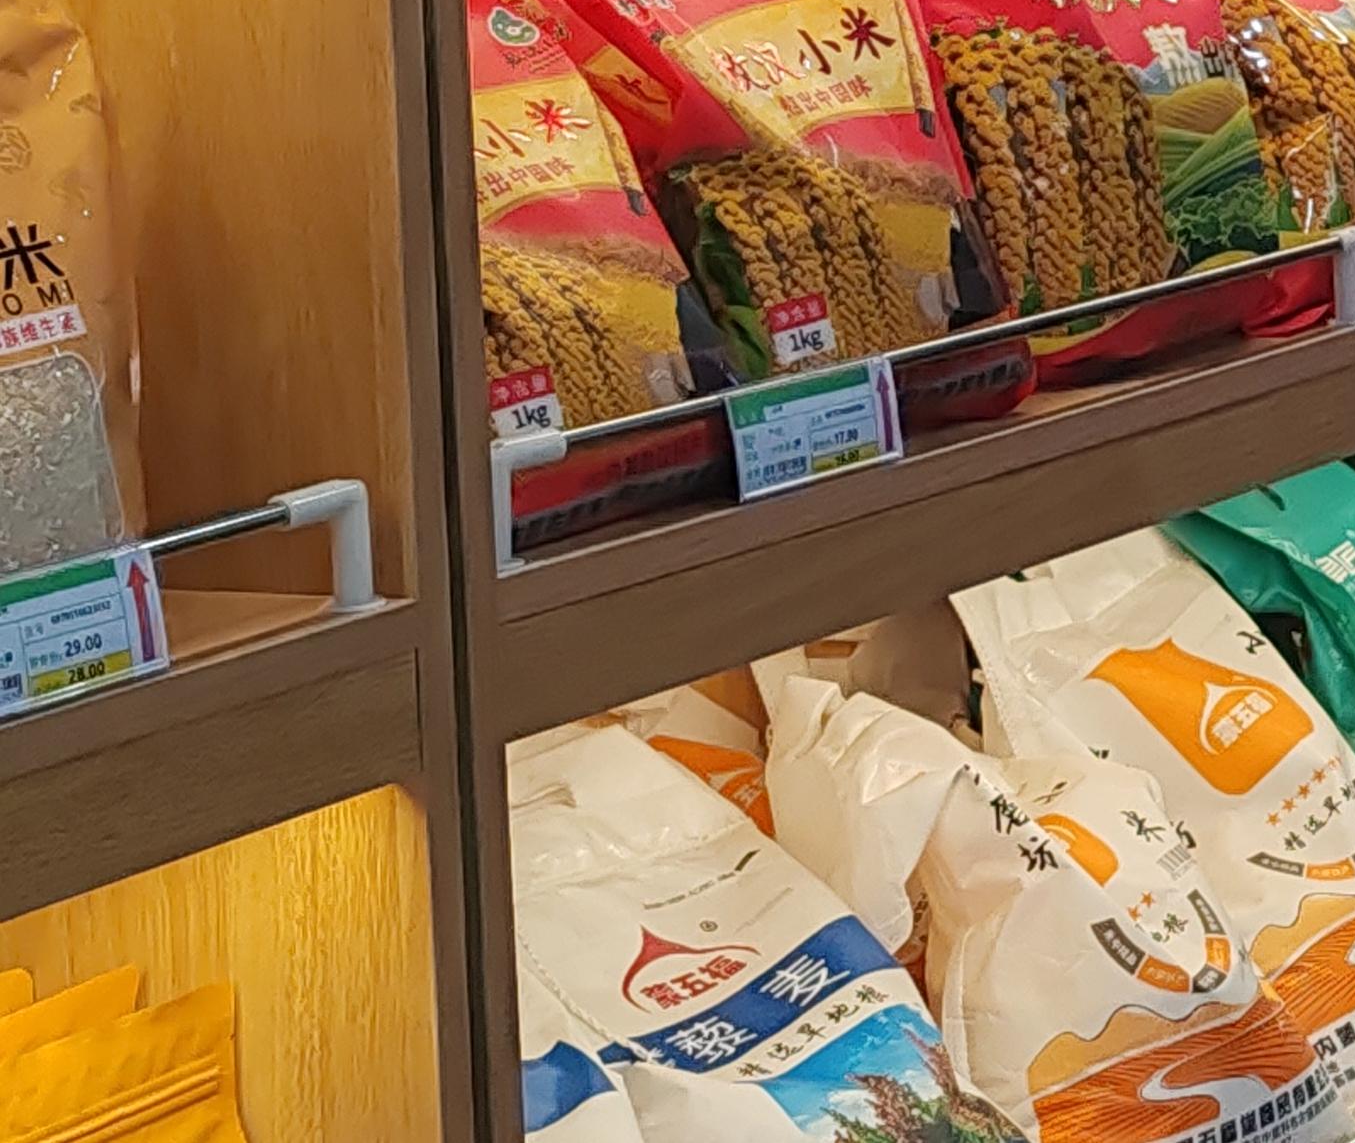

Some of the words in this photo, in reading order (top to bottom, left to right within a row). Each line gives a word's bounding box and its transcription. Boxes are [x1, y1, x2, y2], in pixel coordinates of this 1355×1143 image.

[0, 223, 65, 290] 米
[36, 279, 75, 308] MI
[790, 327, 825, 353] 1kg
[512, 406, 552, 431] 1kg
[64, 633, 102, 658] 29.00
[68, 661, 105, 684] 28.00
